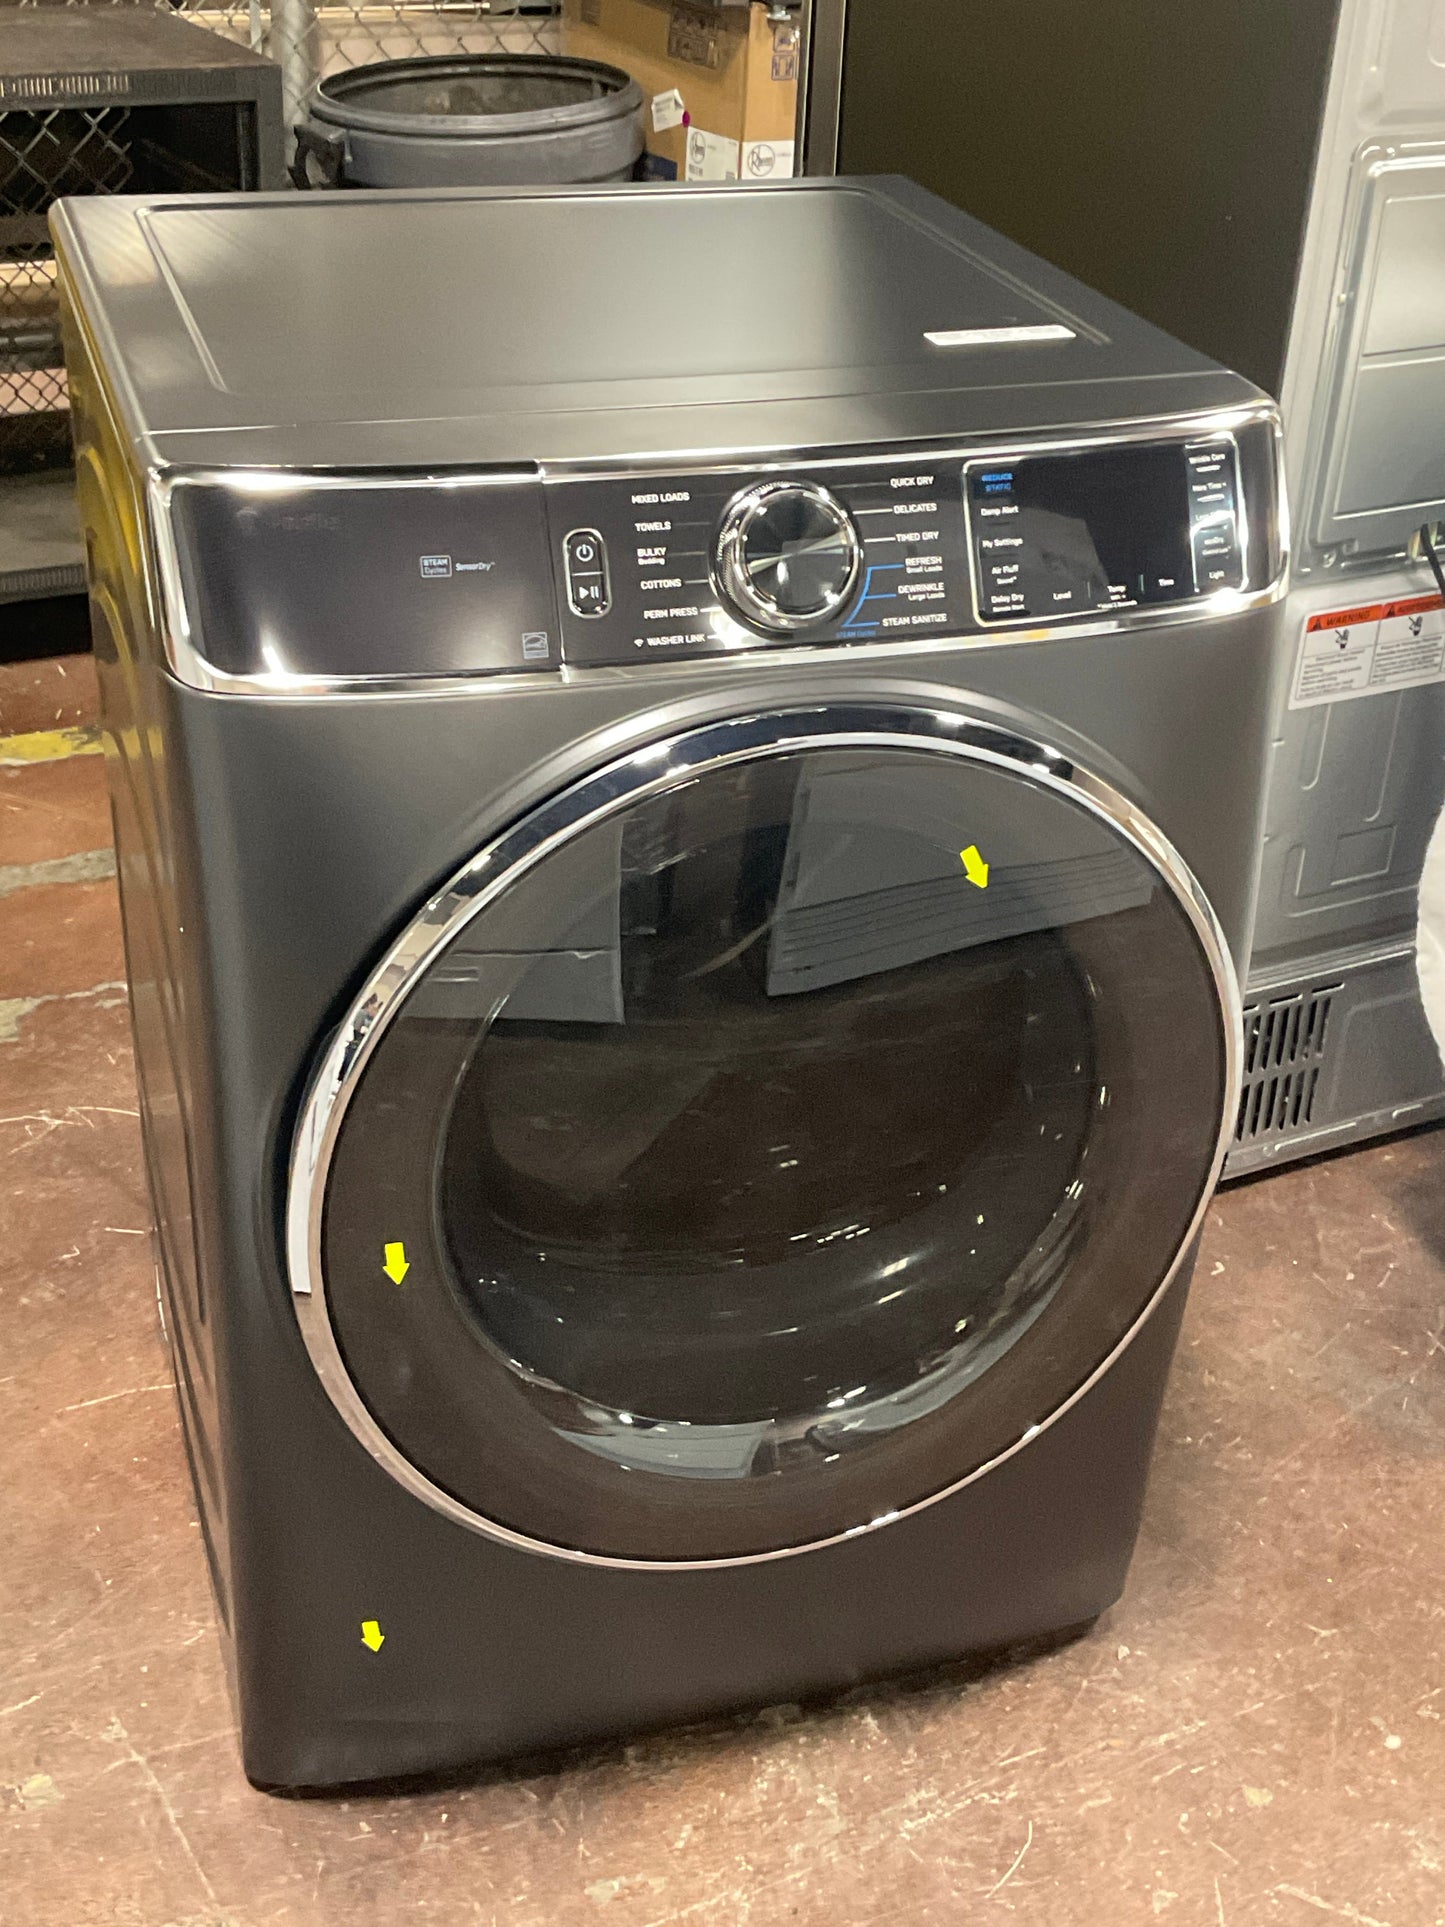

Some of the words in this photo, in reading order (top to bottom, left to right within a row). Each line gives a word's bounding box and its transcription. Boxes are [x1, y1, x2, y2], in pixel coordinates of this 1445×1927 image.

[890, 477, 915, 488] QUICK
[917, 476, 934, 485] DRY
[985, 483, 1011, 492] STATIC
[631, 493, 659, 504] MIXED
[660, 492, 690, 503] LOADS
[893, 503, 937, 514] DELICATES
[980, 507, 1001, 516] Damp
[1001, 505, 1019, 514] Alert
[634, 521, 672, 532] TOWELS
[896, 532, 921, 542] TIMED
[921, 531, 939, 540] DRY
[982, 540, 993, 548] My
[993, 537, 1023, 547] Settings
[637, 547, 667, 557] BULKY
[423, 558, 448, 567] STEAM
[905, 556, 942, 566] REFRESH
[991, 566, 1002, 575] Air
[1208, 570, 1225, 580] Light
[640, 578, 682, 590] COTTONS
[897, 582, 944, 594] DEWRINKLE
[908, 593, 926, 601] Large
[990, 595, 1010, 603] Delay
[1011, 593, 1024, 602] Dry
[1053, 591, 1072, 600] Level
[643, 609, 668, 619] PERM
[669, 607, 699, 617] PRESS
[1326, 610, 1370, 626] WARNING
[882, 617, 911, 627] STEAM
[911, 613, 947, 624] SANITIZE
[646, 635, 684, 647] WASHER
[685, 634, 706, 643] LINK
